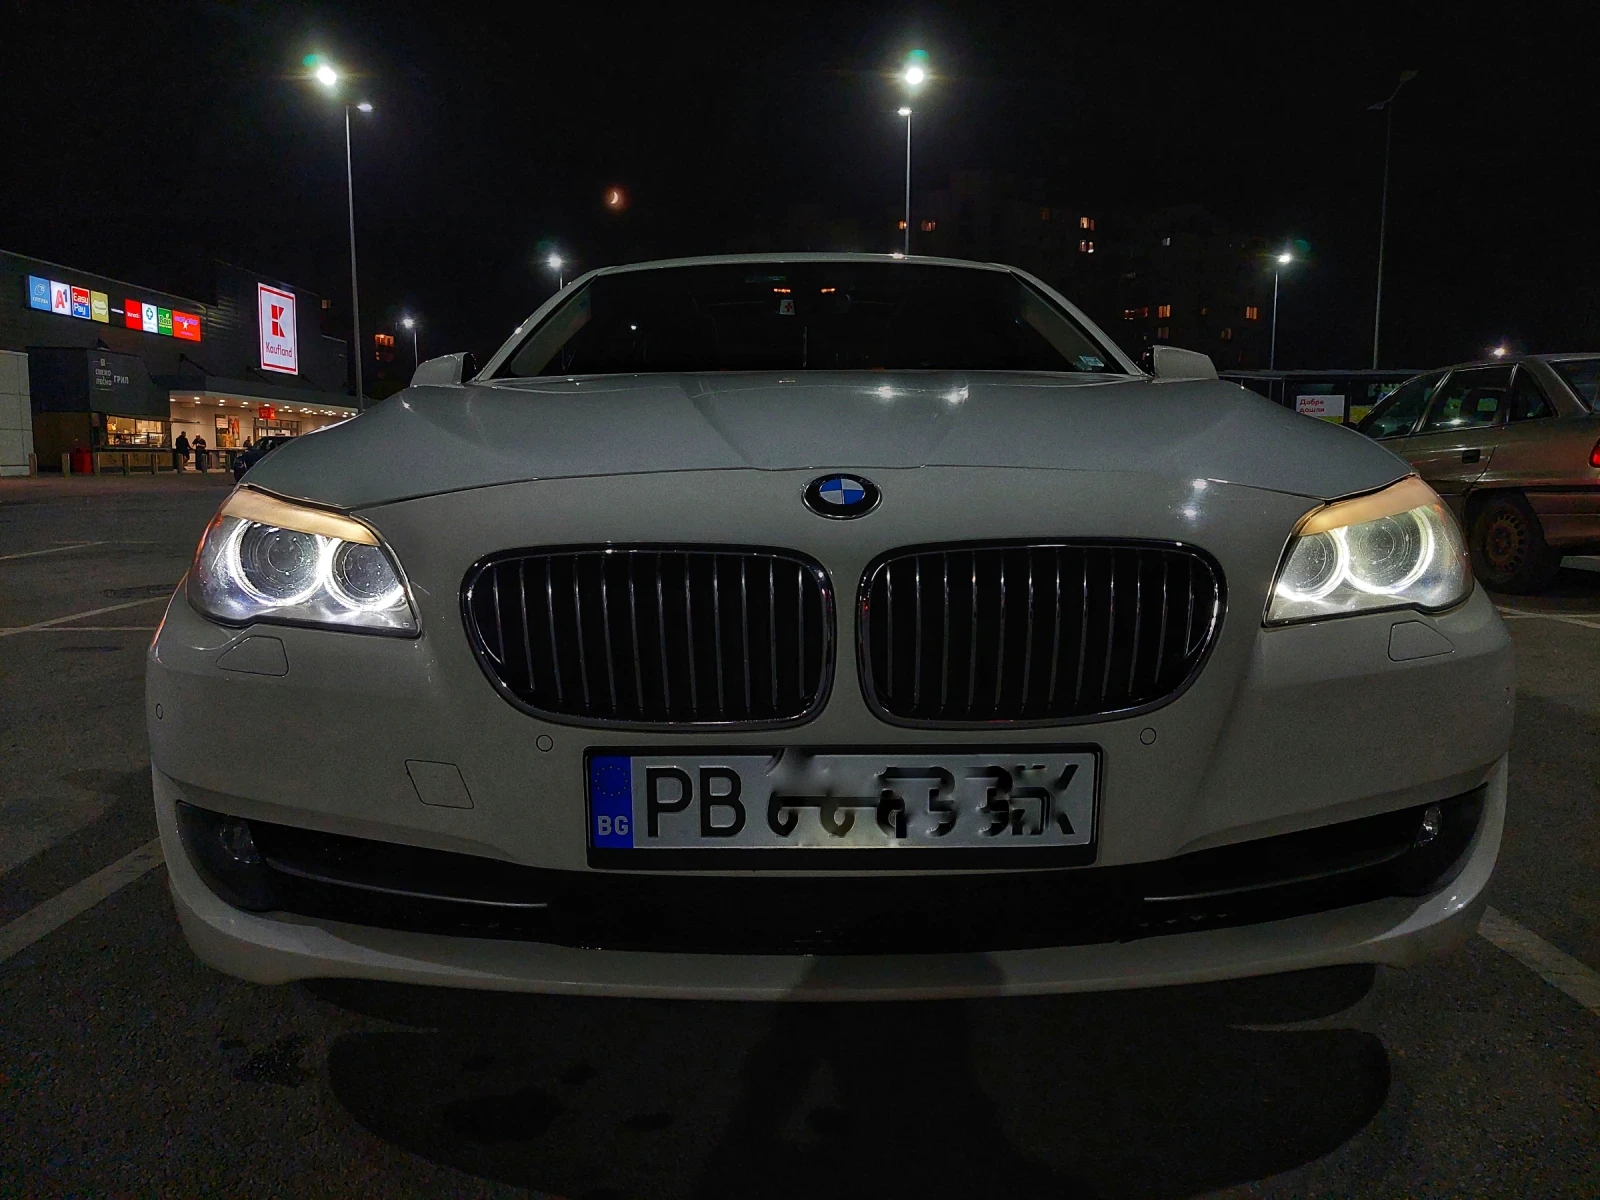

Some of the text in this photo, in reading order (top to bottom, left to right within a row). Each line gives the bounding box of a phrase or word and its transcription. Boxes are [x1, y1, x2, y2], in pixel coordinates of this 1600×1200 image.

[55, 288, 68, 308] A1
[73, 292, 89, 305] Easy
[74, 304, 86, 315] Pay
[265, 341, 293, 357] Kaufland
[597, 815, 629, 836] BG
